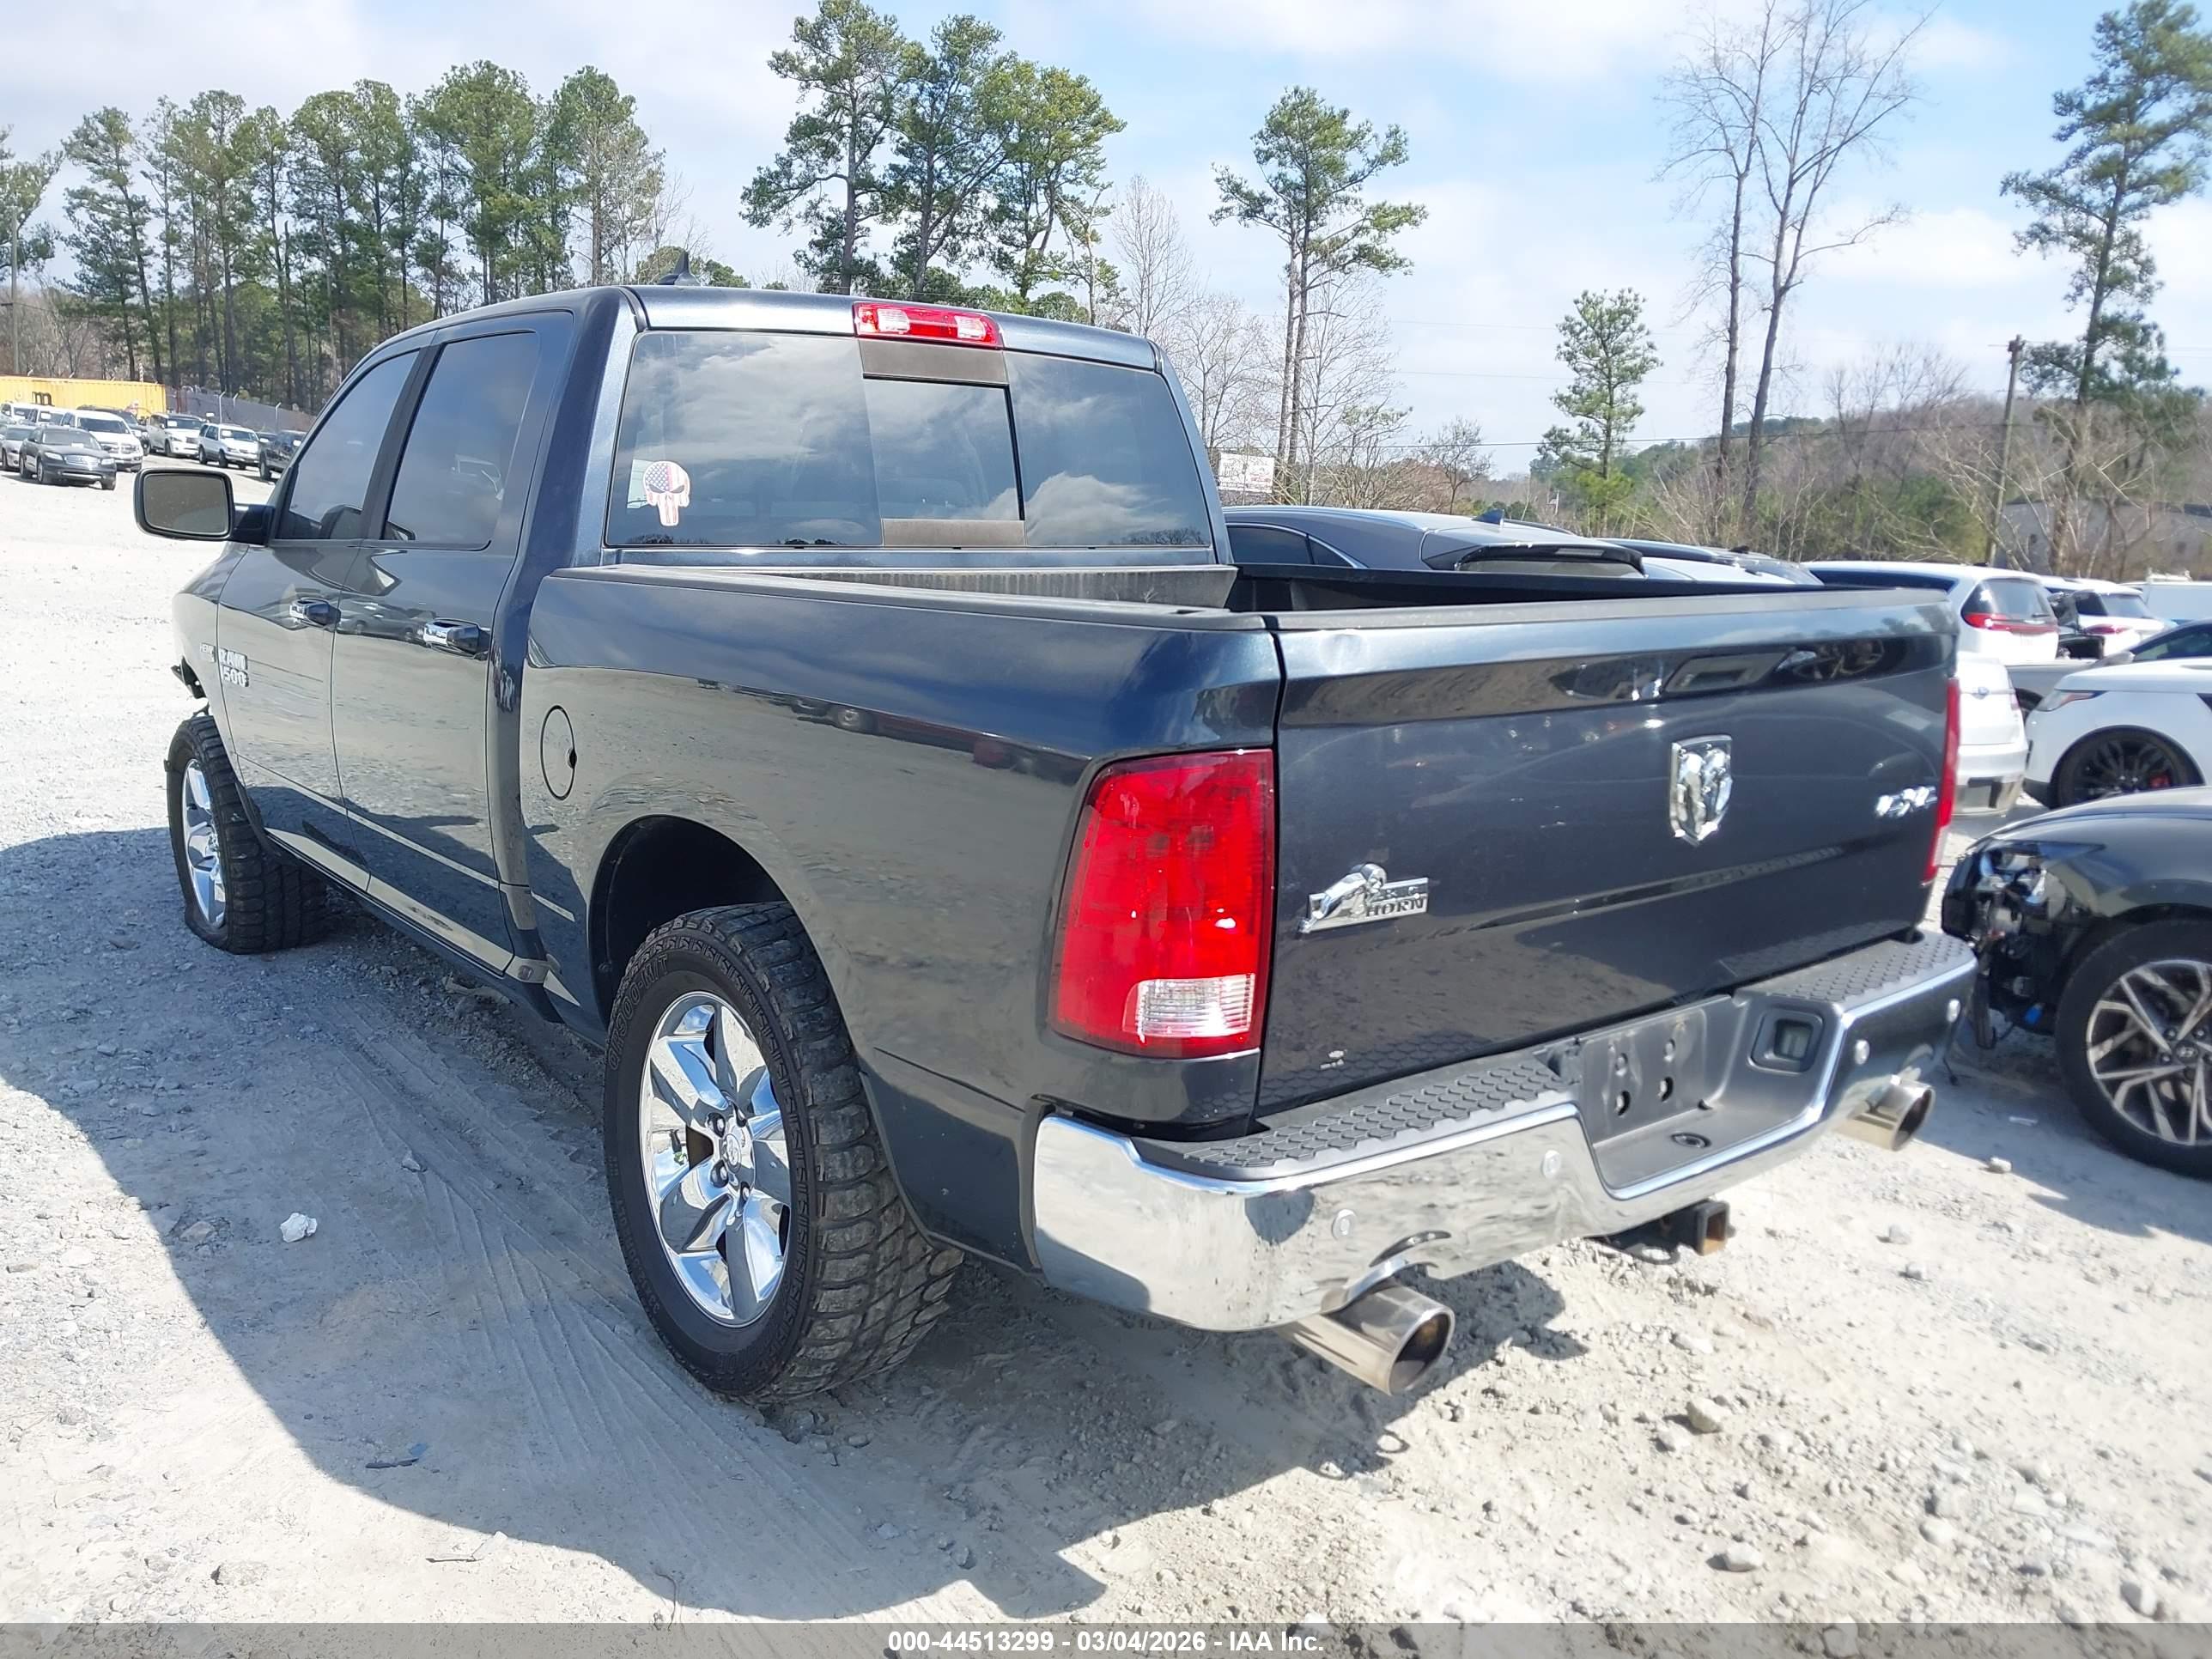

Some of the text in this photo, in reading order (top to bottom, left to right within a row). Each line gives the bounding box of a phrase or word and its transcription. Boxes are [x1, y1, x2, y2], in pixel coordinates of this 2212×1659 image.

[218, 647, 247, 670] RAM
[219, 665, 248, 687] 1500
[1365, 898, 1425, 917] HORN
